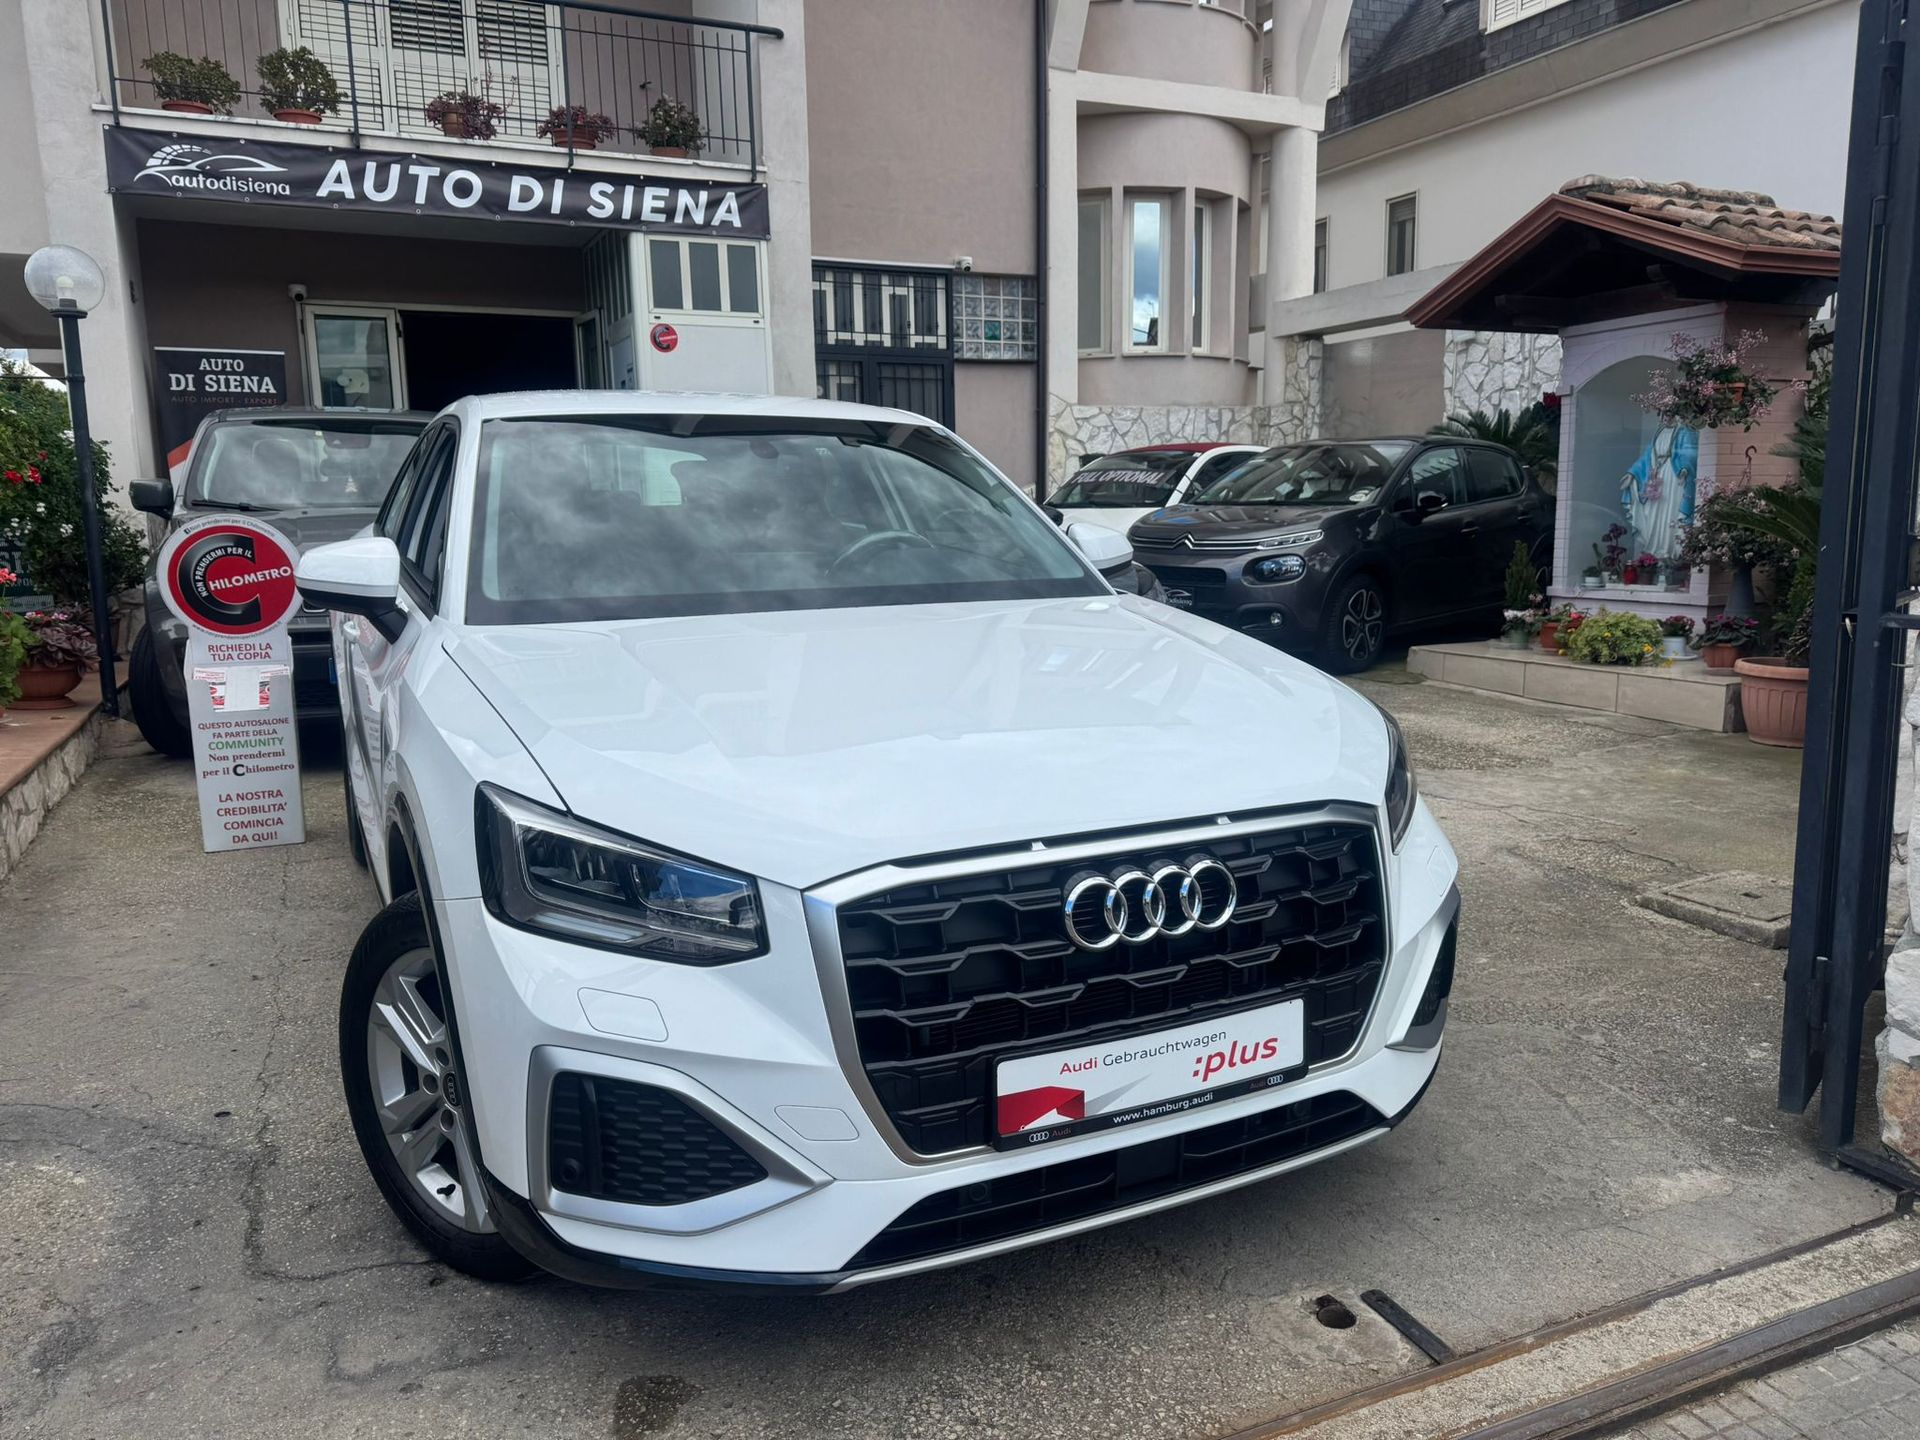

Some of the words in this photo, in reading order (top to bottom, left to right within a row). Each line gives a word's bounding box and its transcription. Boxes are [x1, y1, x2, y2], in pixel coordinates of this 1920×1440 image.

[171, 174, 291, 196] autodisiena
[316, 159, 483, 209] AUTO
[508, 175, 564, 215] DI
[586, 182, 742, 228] SIENA
[199, 358, 244, 372] AUTO
[168, 373, 196, 391] DI
[204, 374, 277, 394] SIENA
[1072, 471, 1103, 484] FULL
[1098, 470, 1165, 485] OPTIONAL
[227, 546, 244, 556] PER
[244, 550, 253, 558] IL
[195, 549, 226, 579] PRENDERMI
[195, 574, 209, 598] NON
[208, 566, 292, 592] HILOMETRO
[207, 643, 256, 653] RICHIEDI
[259, 642, 273, 651] LA
[211, 652, 234, 662] TUA
[236, 651, 272, 661] COPIA
[197, 721, 233, 731] QUESTO
[234, 717, 290, 728] AUTOSALONE
[212, 732, 223, 740] FA
[224, 730, 251, 739] PARTE
[252, 728, 278, 737] DELLA
[208, 737, 285, 751] COMMUNITY
[208, 753, 230, 762] Non
[232, 749, 286, 763] prendermi
[202, 769, 220, 779] per
[222, 767, 230, 776] il
[232, 763, 295, 777] Chilometro
[218, 793, 233, 803] LA
[236, 789, 284, 801] NOSTRA
[223, 817, 284, 831] COMINCIA
[232, 834, 249, 844] DA
[251, 831, 278, 842] QUI!
[1059, 1056, 1098, 1076] Audi
[1102, 1030, 1228, 1067] Gebrauchtwagen
[1113, 1092, 1213, 1124] www.hamburg.audi
[1052, 1127, 1072, 1137] Audi
